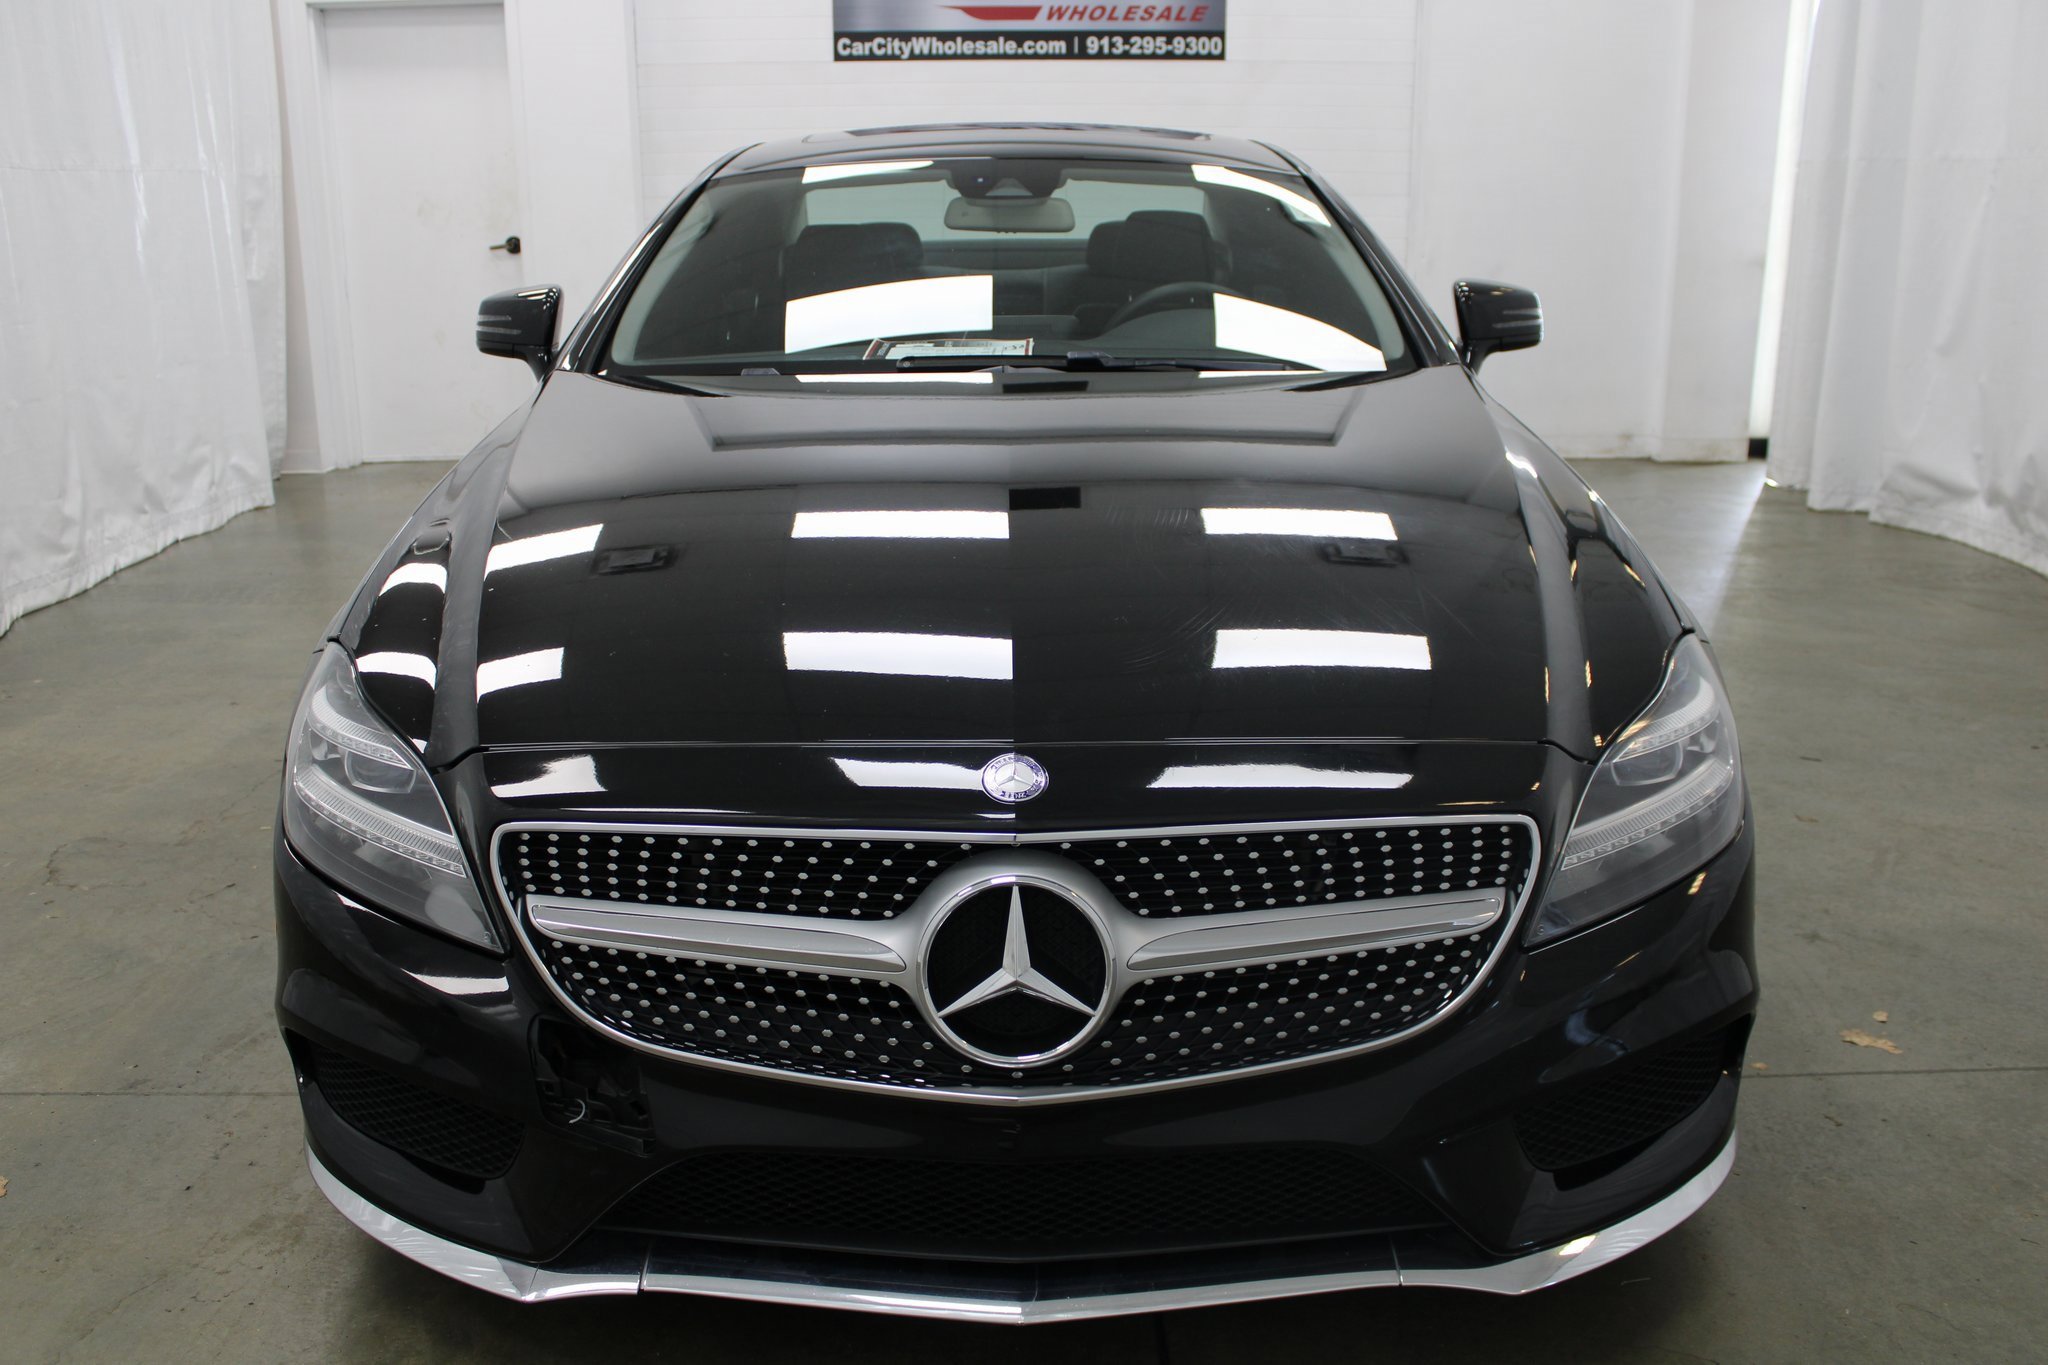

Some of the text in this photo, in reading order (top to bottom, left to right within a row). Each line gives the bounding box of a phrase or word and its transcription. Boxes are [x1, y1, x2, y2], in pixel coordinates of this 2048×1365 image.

[1045, 5, 1209, 22] WHOLESALE
[836, 36, 1067, 59] CarCityWholesale.com
[1086, 36, 1223, 56] 913-295-9300
